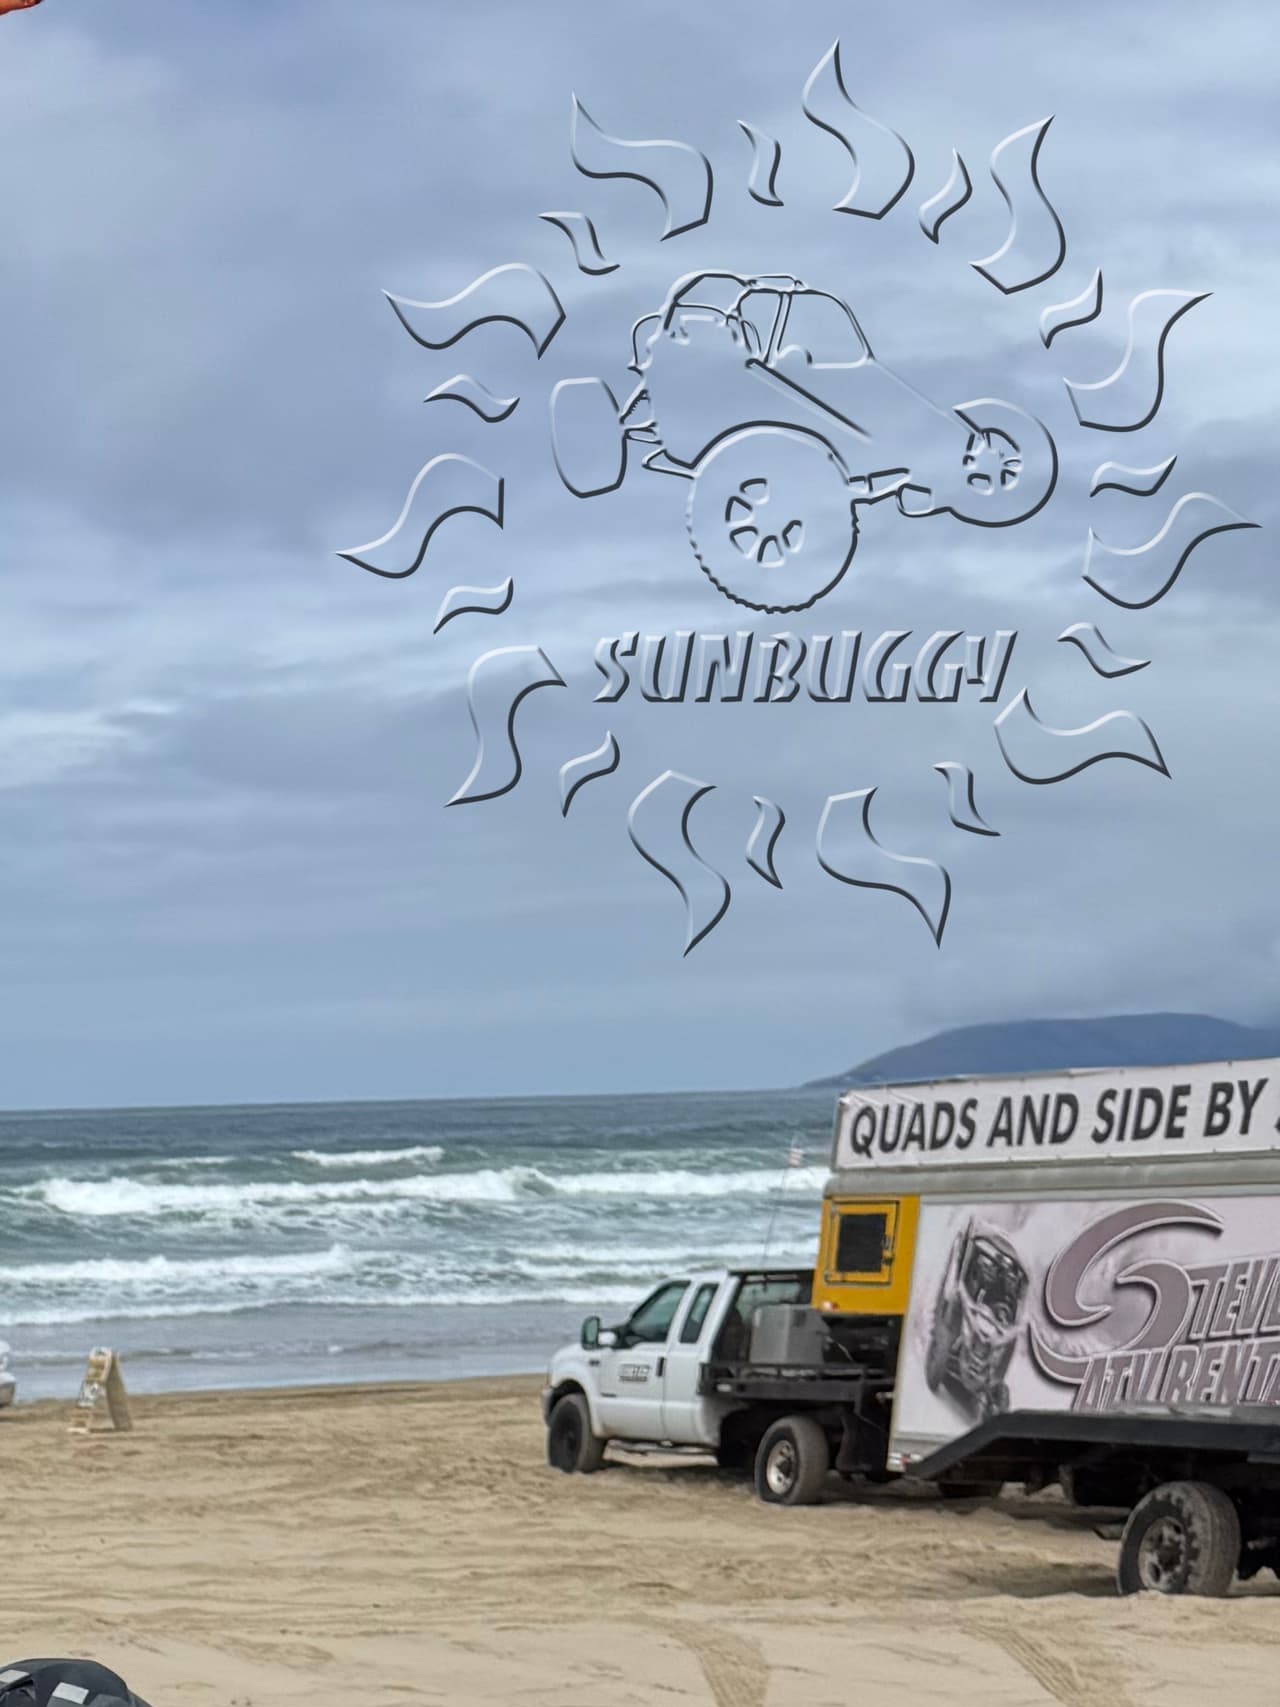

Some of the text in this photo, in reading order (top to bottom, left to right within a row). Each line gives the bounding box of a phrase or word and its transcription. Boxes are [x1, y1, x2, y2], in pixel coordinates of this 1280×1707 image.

[849, 1077, 1269, 1159] QUADS AND SIDE BY
[1161, 1336, 1280, 1403] RENT
